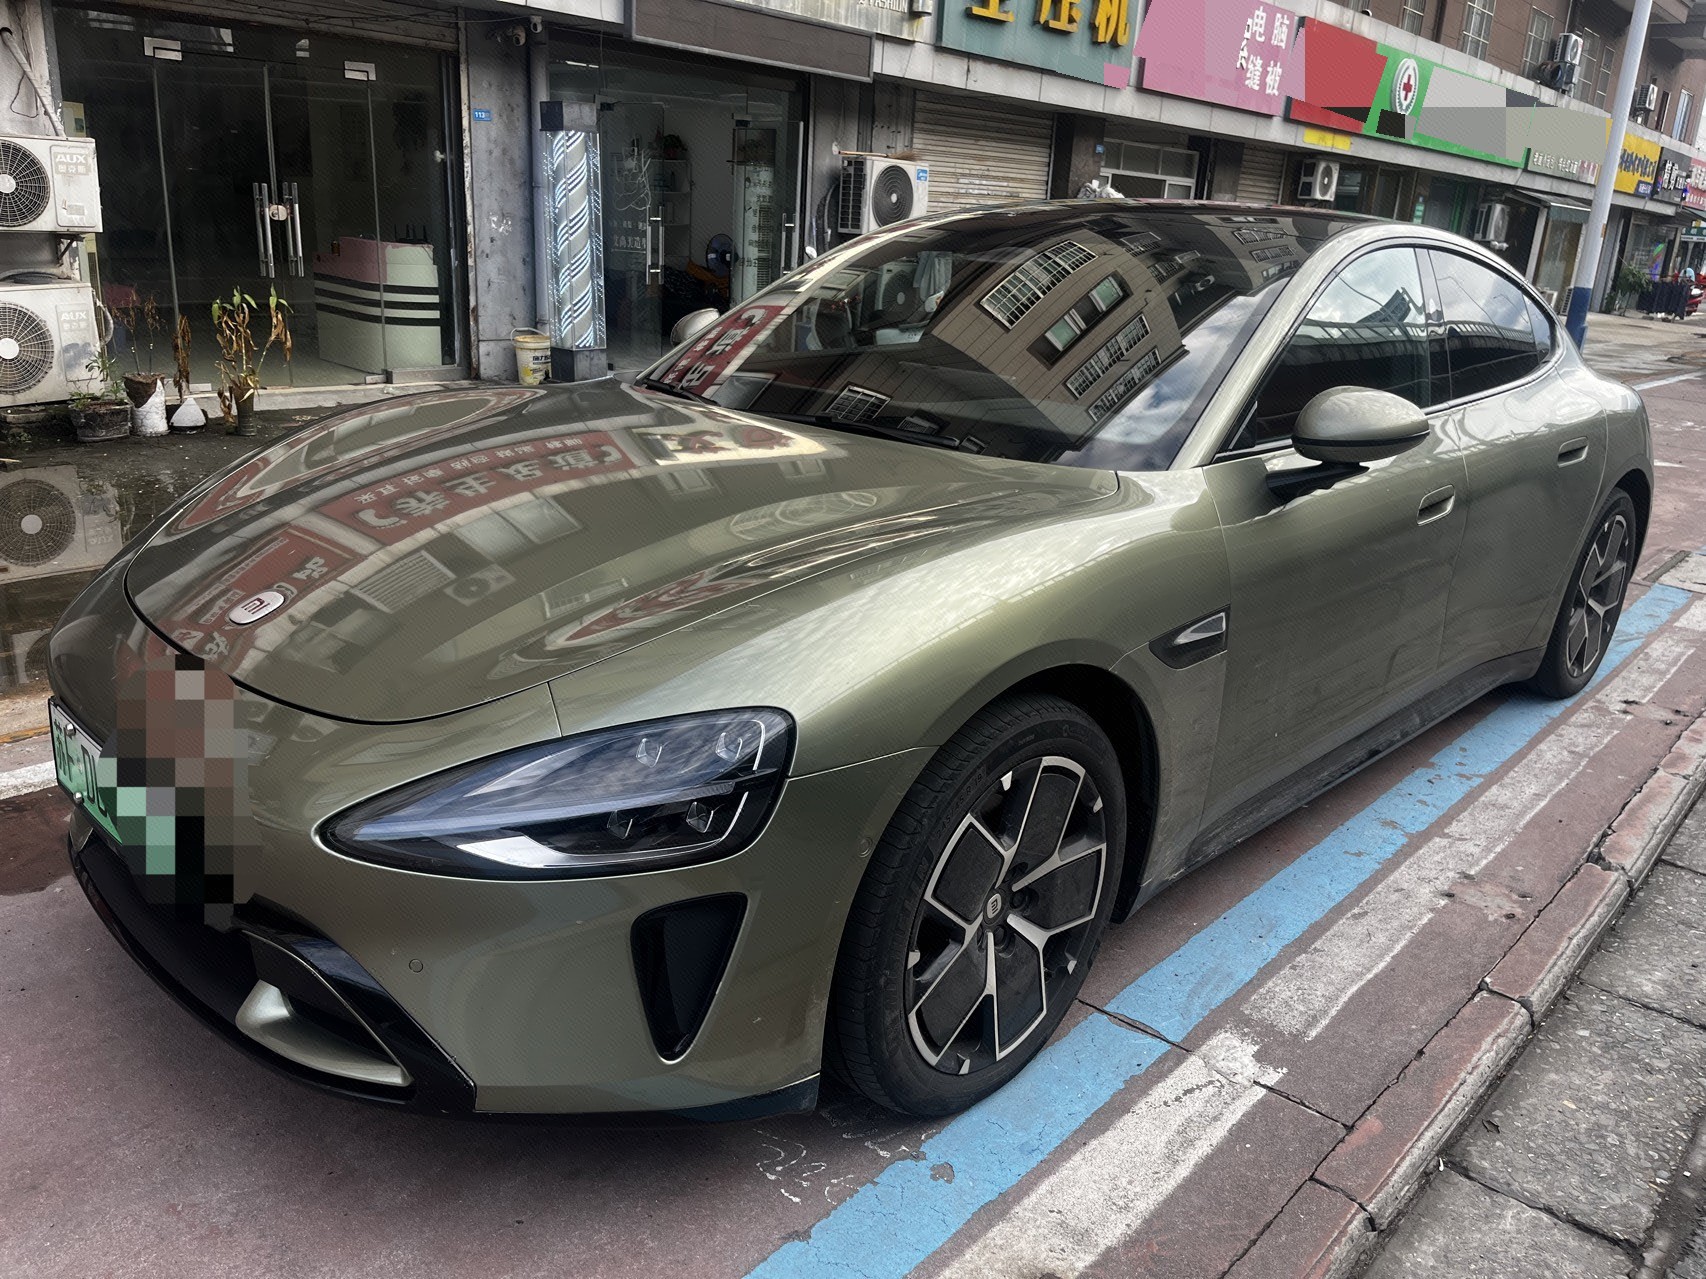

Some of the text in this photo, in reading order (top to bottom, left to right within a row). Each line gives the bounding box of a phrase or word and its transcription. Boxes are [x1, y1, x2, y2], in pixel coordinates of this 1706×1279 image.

[1252, 6, 1290, 49] 电脑
[56, 154, 86, 163] AUX
[61, 311, 88, 320] AUX
